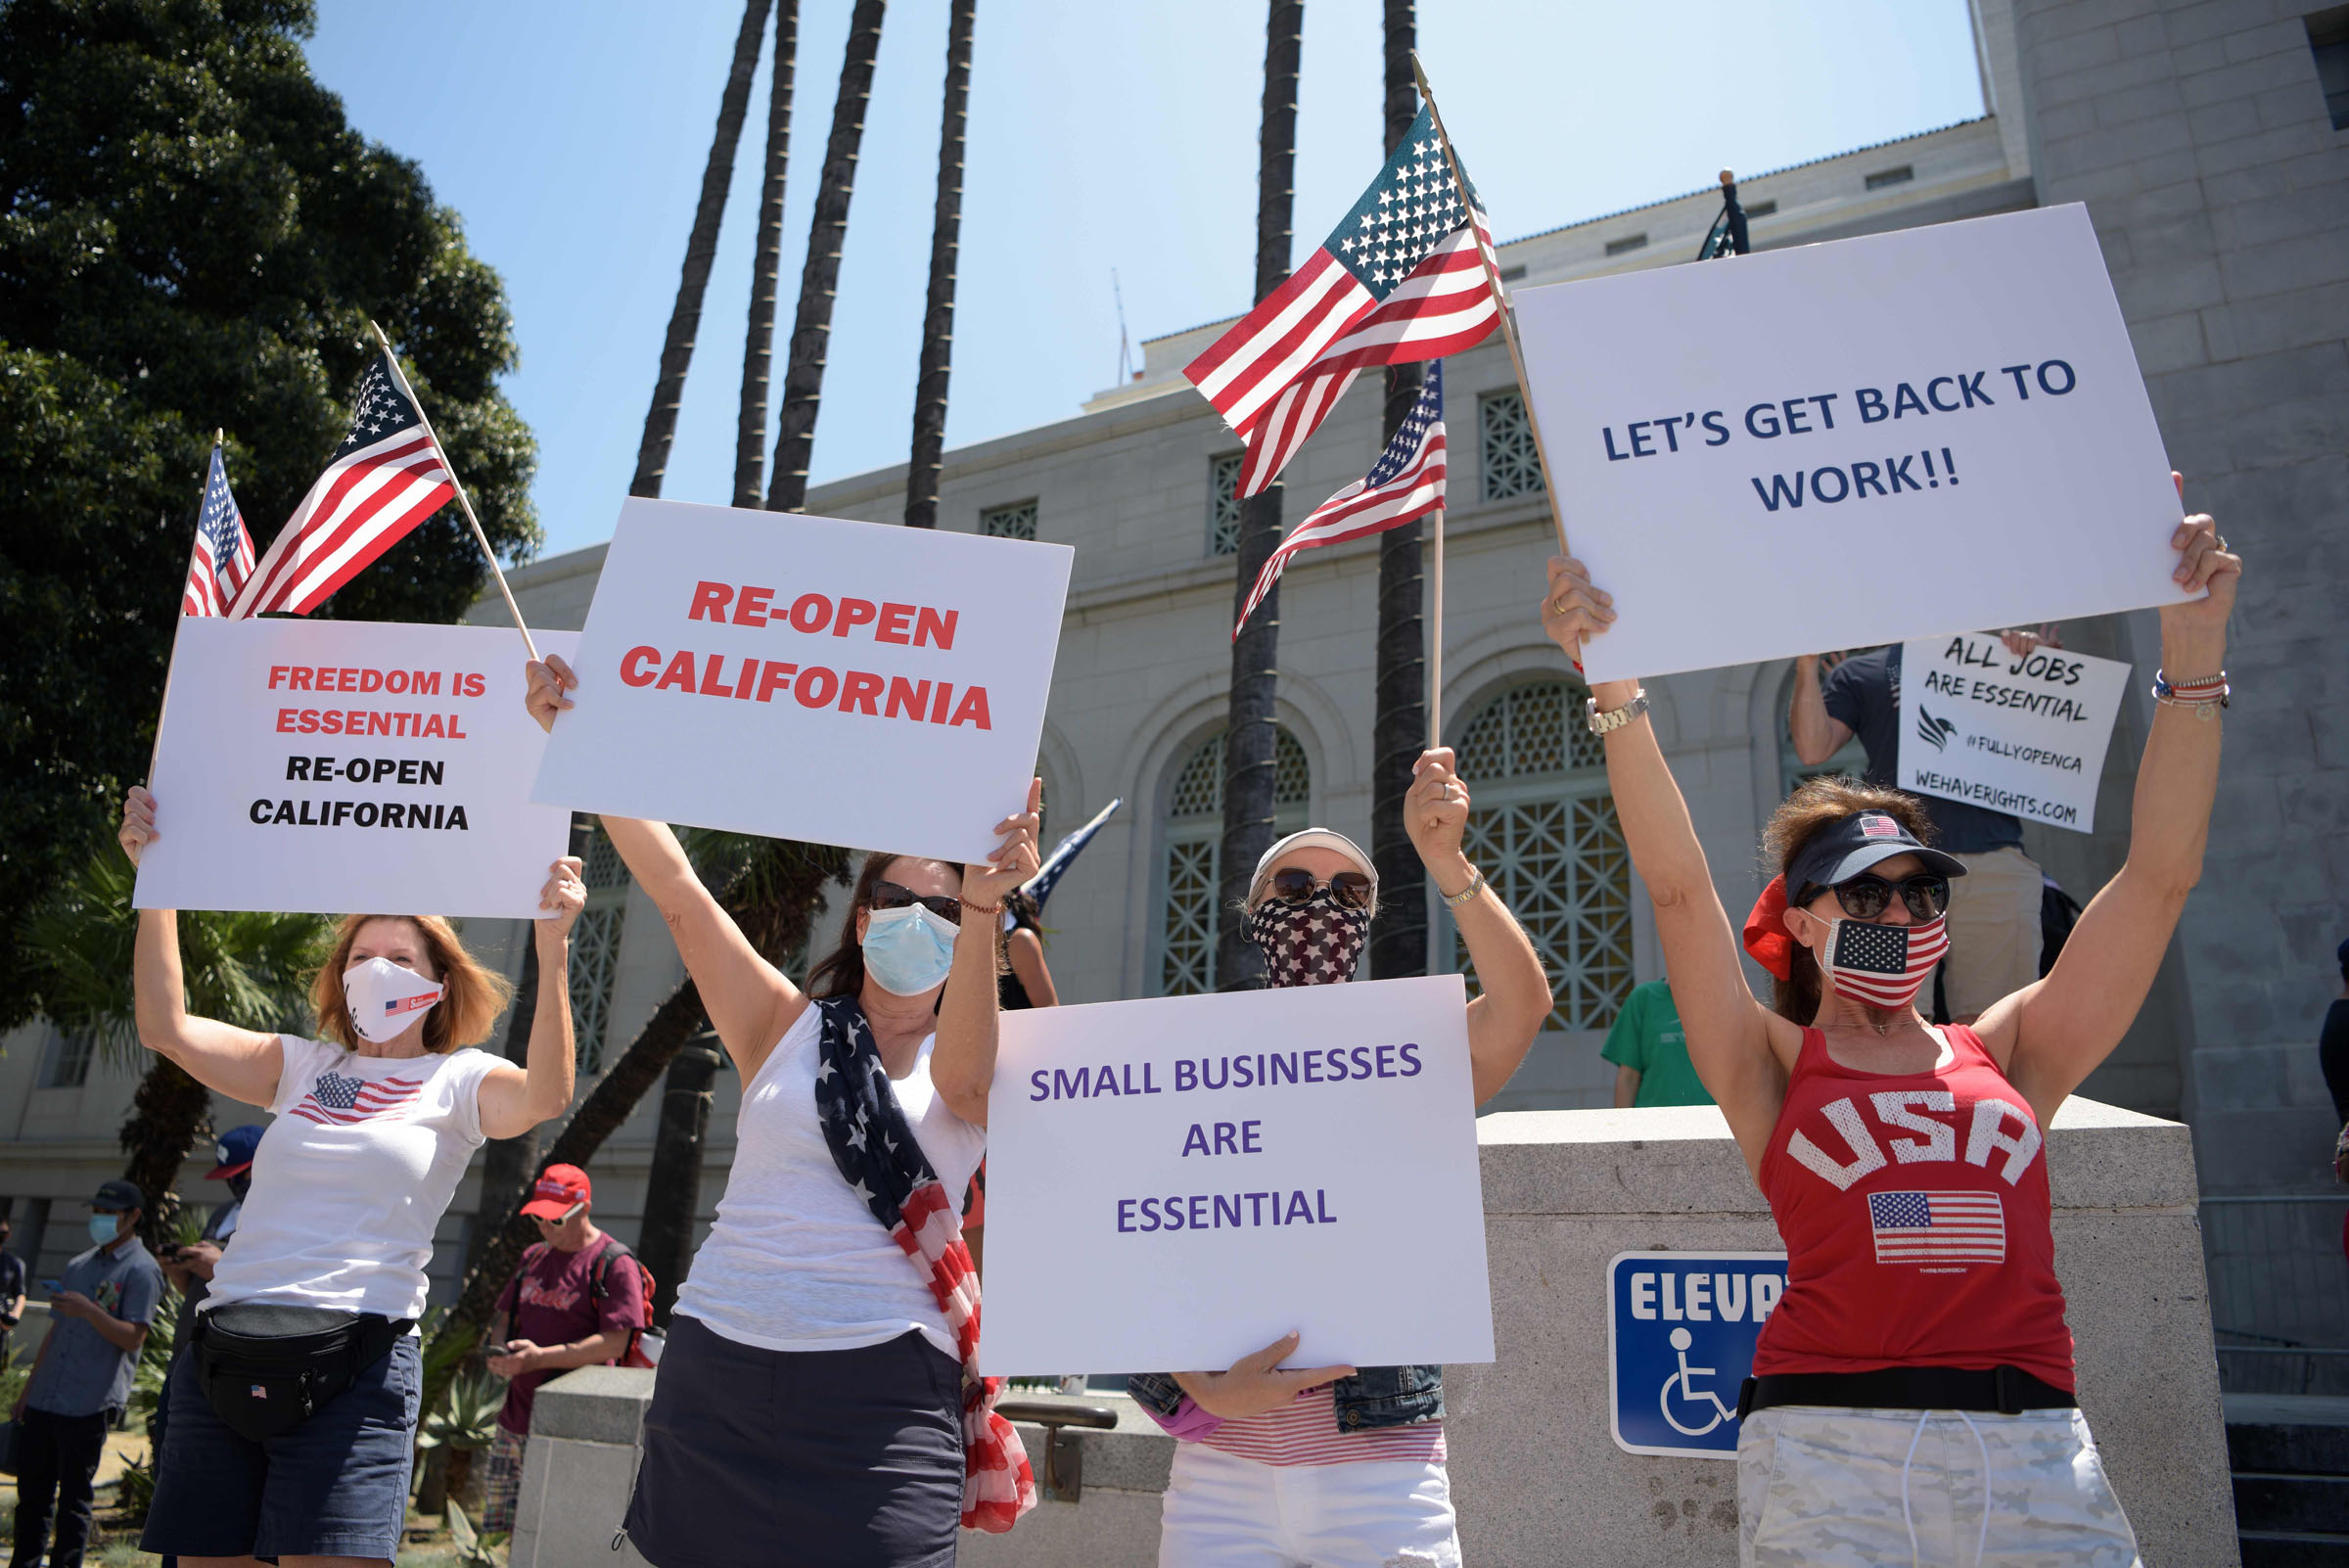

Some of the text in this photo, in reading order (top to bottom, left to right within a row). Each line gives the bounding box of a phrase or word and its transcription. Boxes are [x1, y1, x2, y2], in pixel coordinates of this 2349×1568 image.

[1602, 359, 2076, 462] LET'S GET BACK TO
[1751, 447, 1958, 511] WORK!!
[688, 581, 958, 650] RE-OPEN
[268, 666, 485, 697] FREEDOM IS
[1945, 637, 2084, 685] ALL JOBS
[621, 646, 991, 730] CALIFORNIA
[1925, 670, 2089, 722] ARE ESSENTIAL
[276, 709, 466, 739] ESSENTIAL
[286, 757, 444, 785] RE-OPEN
[1915, 769, 2077, 824] WEHAVERIGHTS.COM
[250, 799, 468, 830] CALIFORNIA
[1031, 1043, 1421, 1101] SMALL BUSINESSES
[1182, 1121, 1262, 1157] ARE
[1786, 1090, 2043, 1192] USA
[1118, 1189, 1337, 1232] ESSENTIAL
[1631, 1272, 1790, 1322] ELEVA
